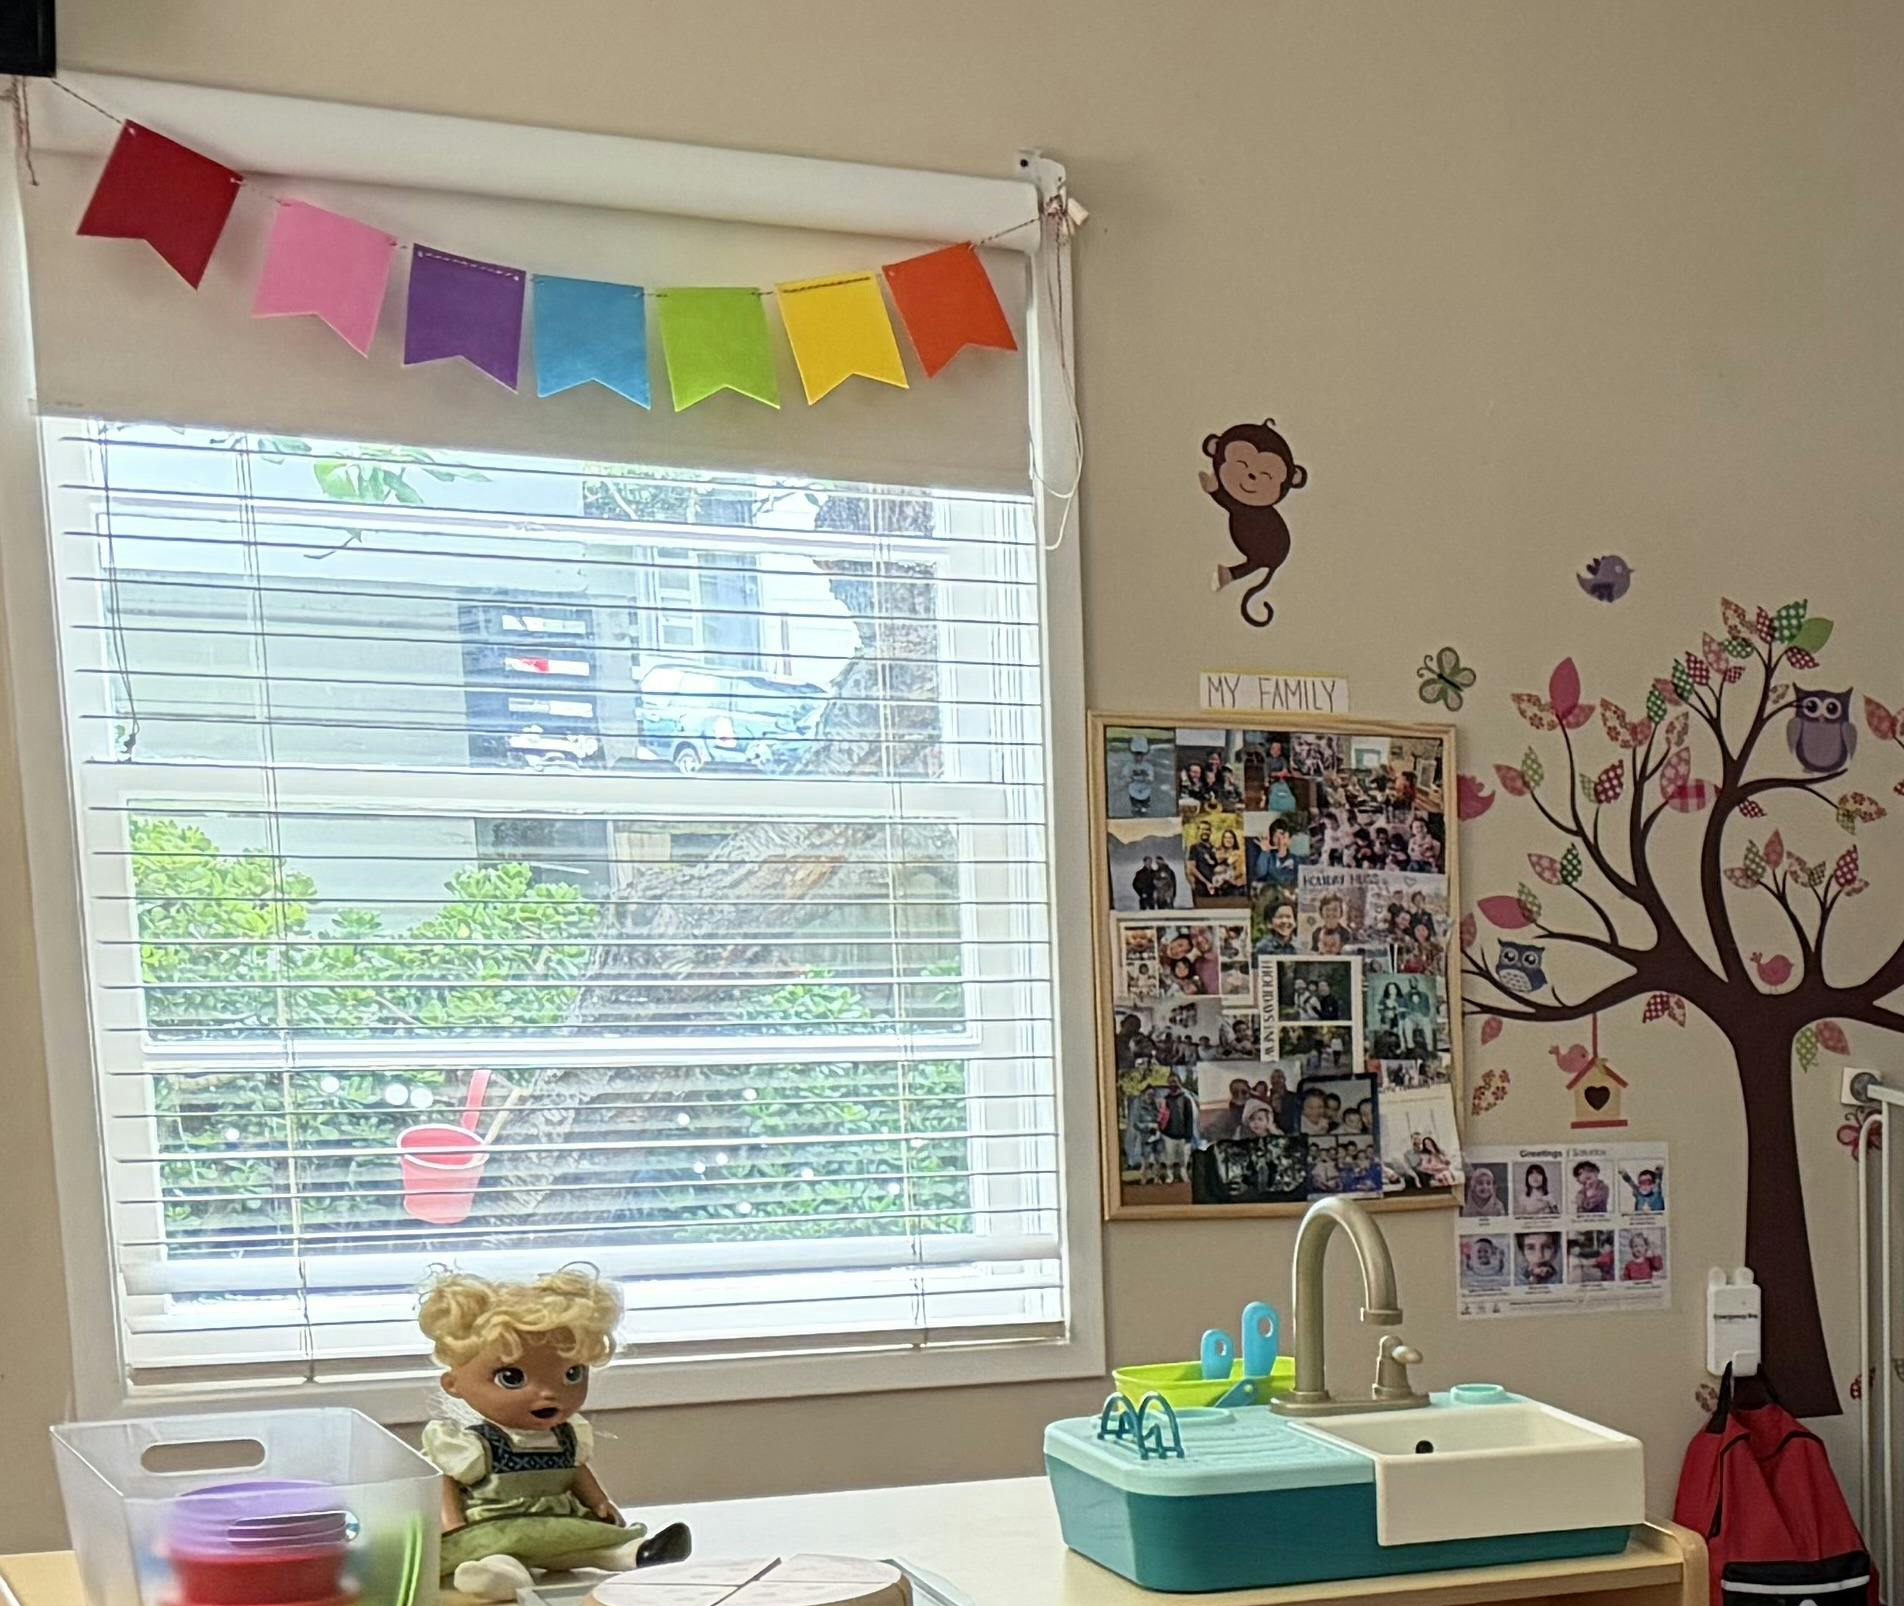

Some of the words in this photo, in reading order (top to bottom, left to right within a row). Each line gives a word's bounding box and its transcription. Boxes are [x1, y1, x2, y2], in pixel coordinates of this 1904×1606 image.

[1207, 675, 1241, 708] MY
[1258, 676, 1337, 712] FAMILY
[1519, 1149, 1563, 1159] Greetings
